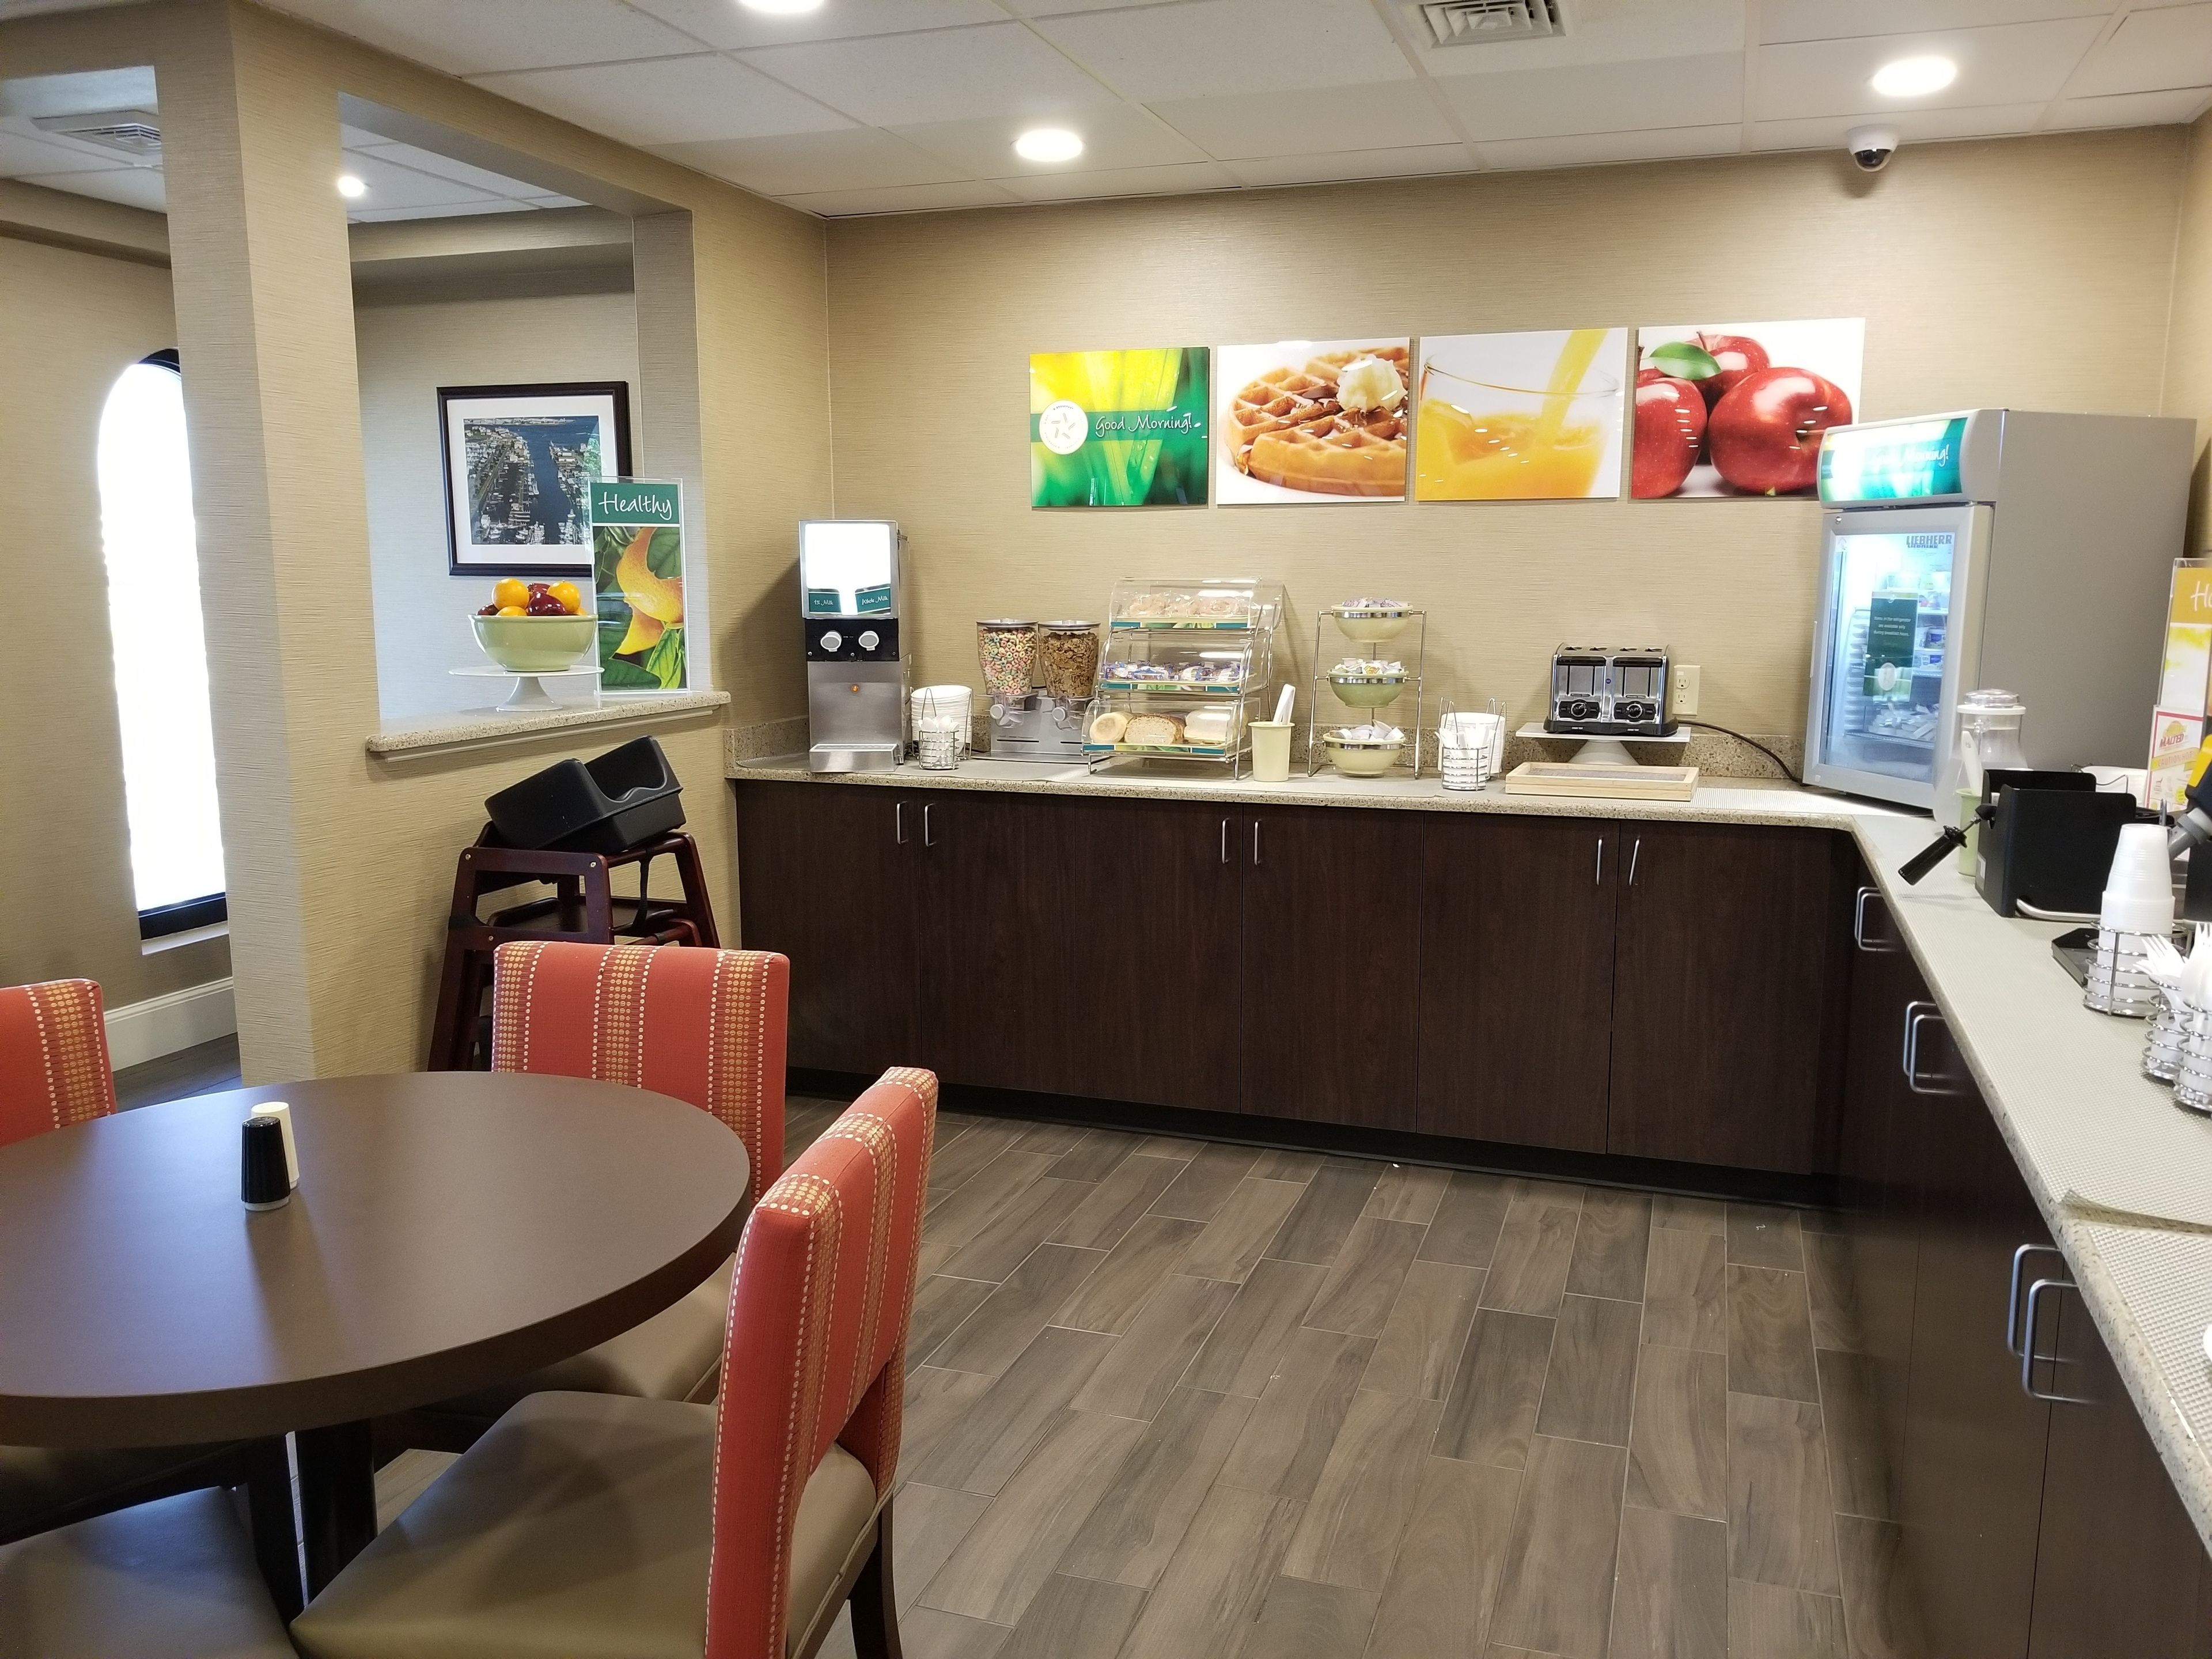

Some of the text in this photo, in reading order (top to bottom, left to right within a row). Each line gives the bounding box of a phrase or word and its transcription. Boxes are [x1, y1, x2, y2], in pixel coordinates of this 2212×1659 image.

[1095, 414, 1192, 438] Good Morning!
[598, 491, 672, 521] Healthy
[1906, 535, 1952, 545] LIEBHERR
[2160, 733, 2184, 748] MALTED
